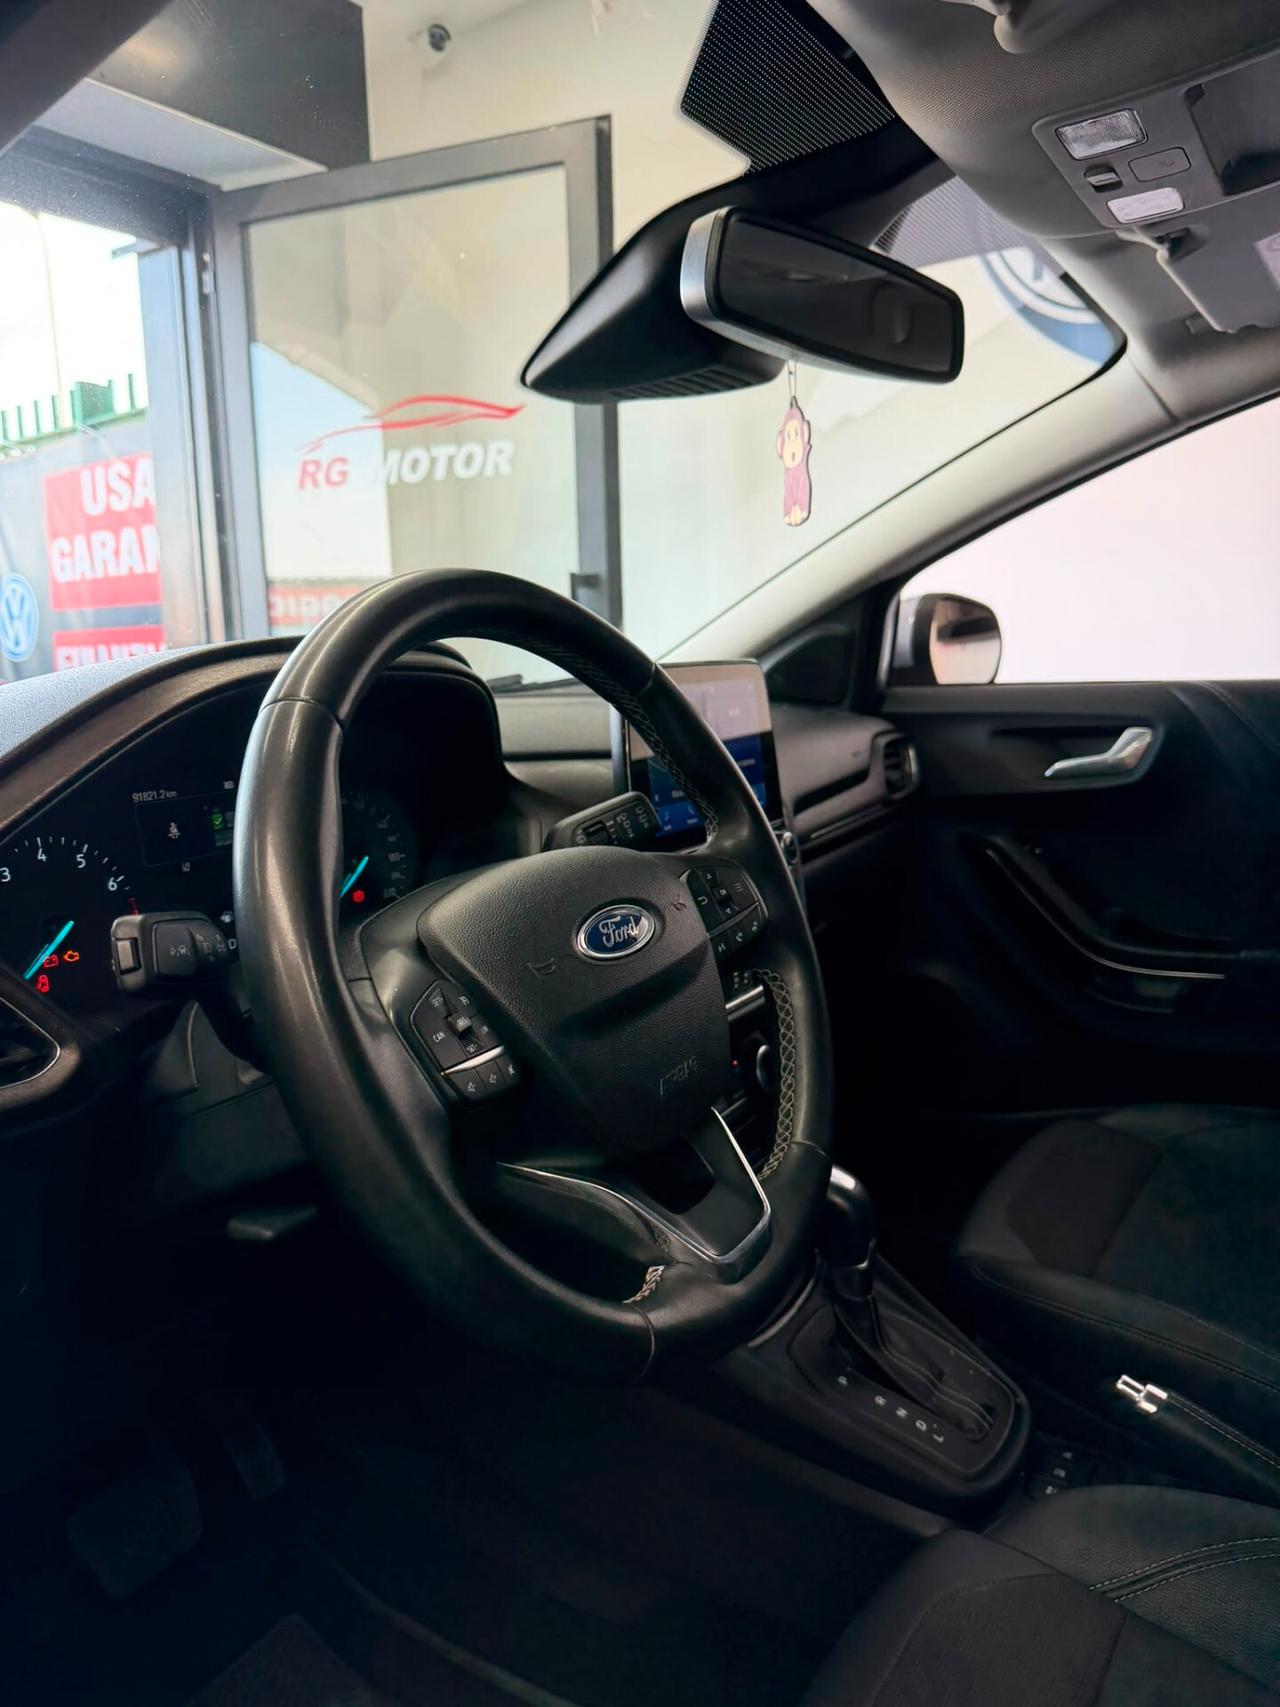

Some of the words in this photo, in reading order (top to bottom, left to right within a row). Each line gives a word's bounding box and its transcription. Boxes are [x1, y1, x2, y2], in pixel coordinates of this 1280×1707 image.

[298, 457, 349, 490] RG
[37, 848, 47, 862] 4
[76, 854, 86, 868] 5
[0, 867, 11, 882] 3
[108, 877, 118, 891] 6
[599, 915, 639, 948] Ford
